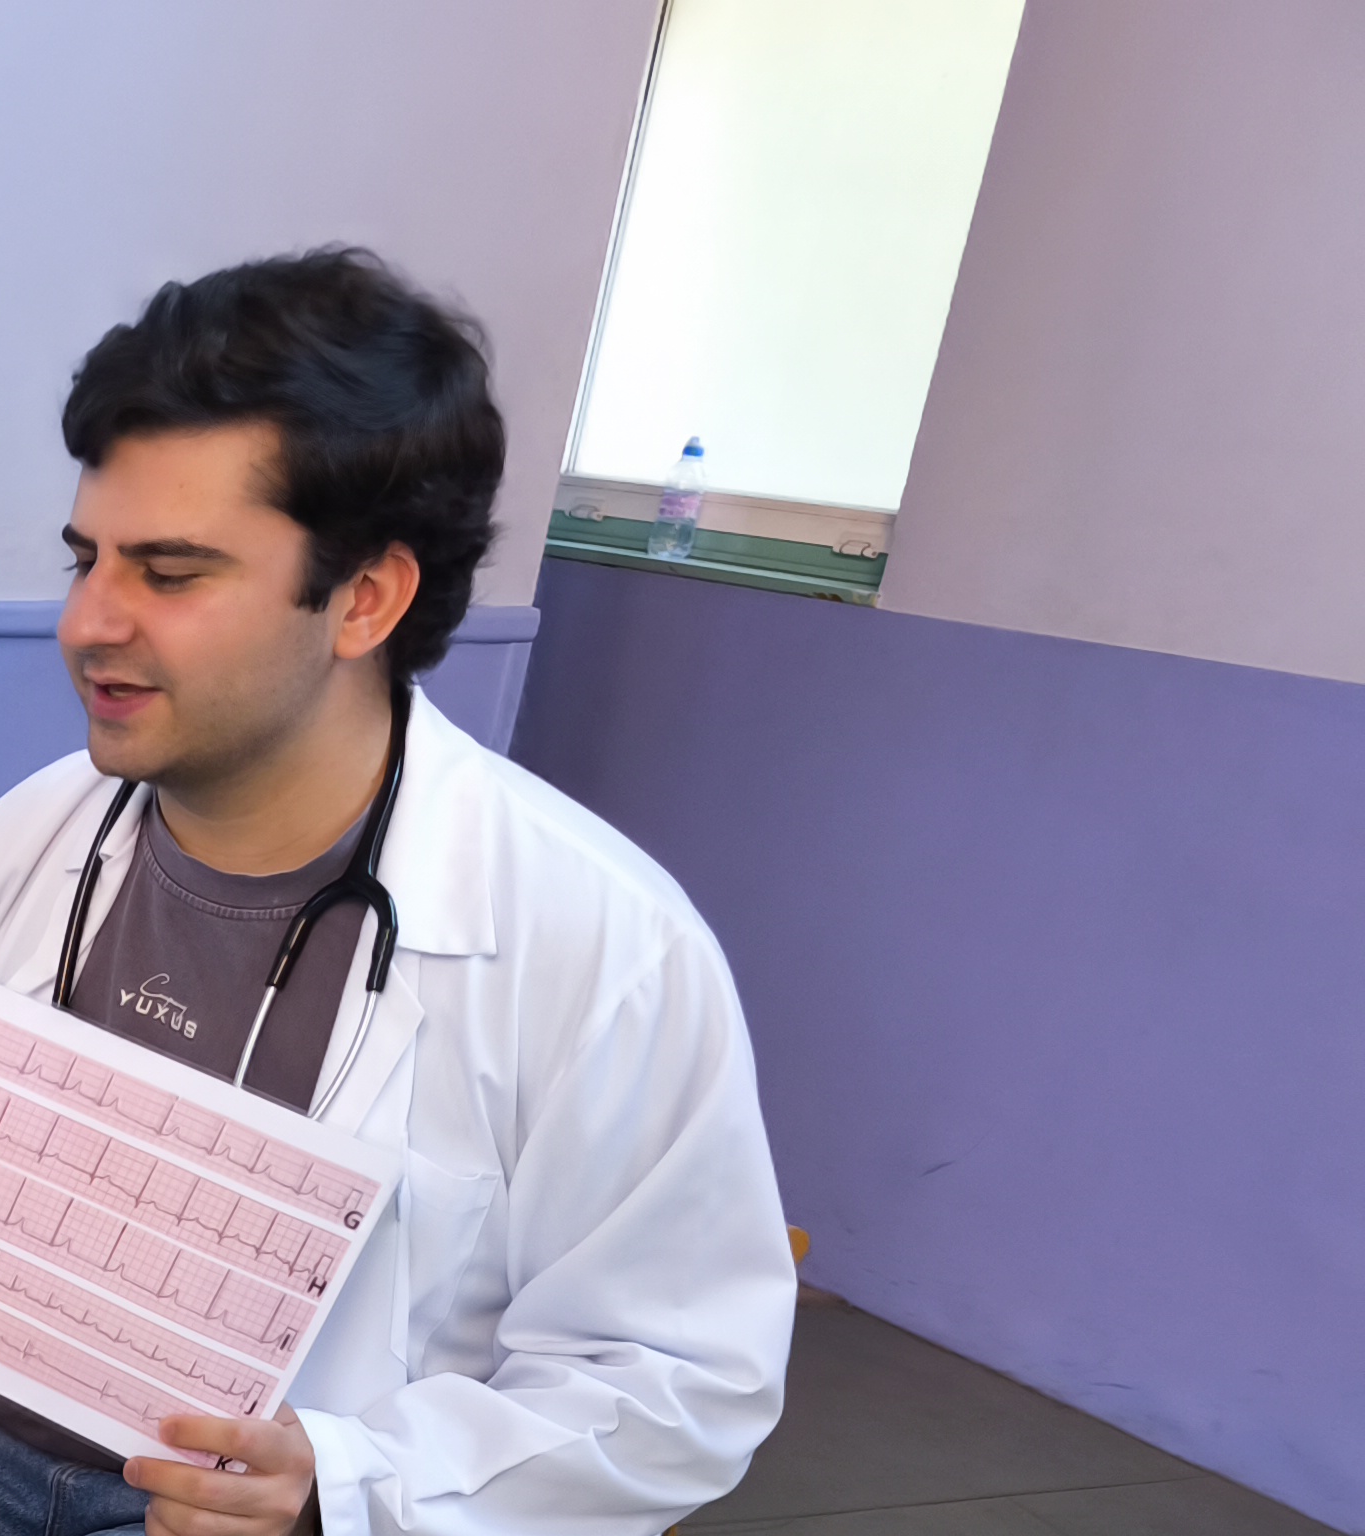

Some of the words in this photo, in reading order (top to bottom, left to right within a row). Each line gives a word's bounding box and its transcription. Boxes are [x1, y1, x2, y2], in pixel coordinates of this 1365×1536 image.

[119, 988, 198, 1039] YUXUS
[343, 1210, 365, 1230] G
[306, 1276, 327, 1297] H
[243, 1399, 259, 1415] J
[214, 1455, 234, 1471] K
